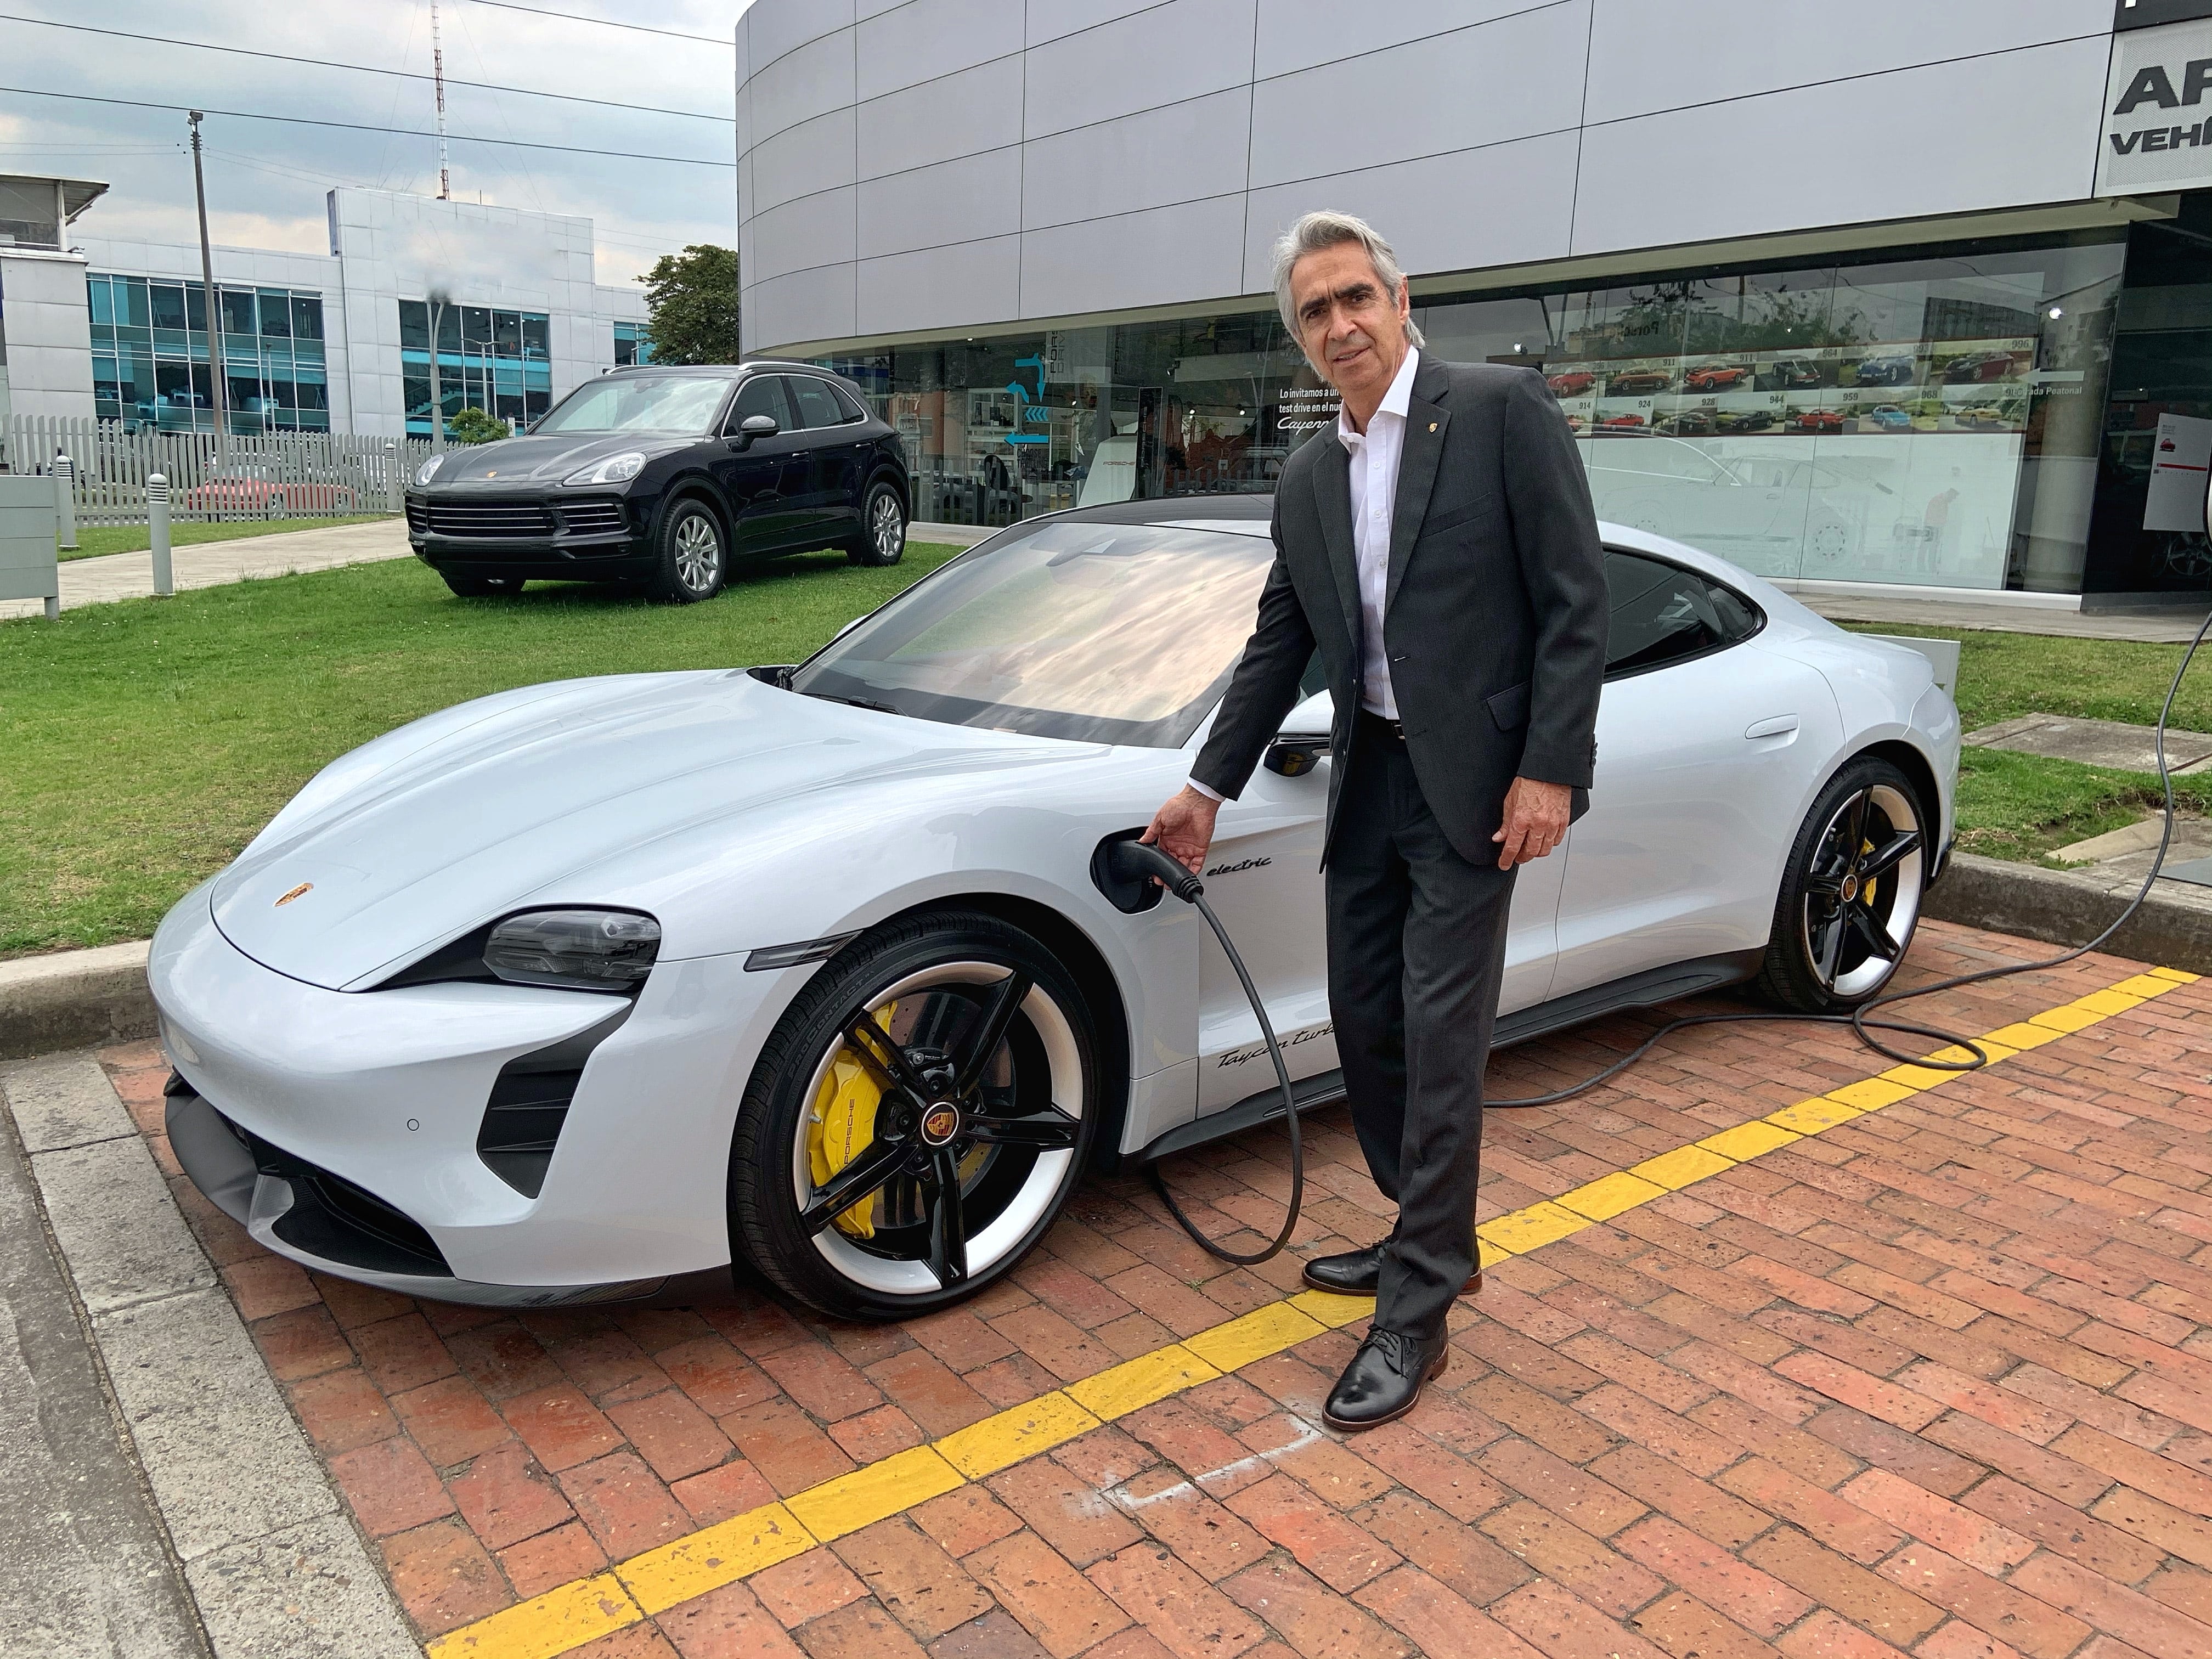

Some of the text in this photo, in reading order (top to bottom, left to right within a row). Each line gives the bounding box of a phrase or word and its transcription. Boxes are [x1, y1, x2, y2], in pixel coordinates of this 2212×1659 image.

[1280, 388, 1288, 398] Lo
[1289, 388, 1323, 398] invitamos
[1843, 393, 1858, 401] 959
[1770, 395, 1784, 403] 944
[1279, 404, 1293, 413] test
[1294, 403, 1311, 413] drive
[1312, 403, 1321, 412] en
[1322, 401, 1328, 411] el
[1206, 857, 1272, 876] electric
[844, 1098, 855, 1165] PORSCHE
